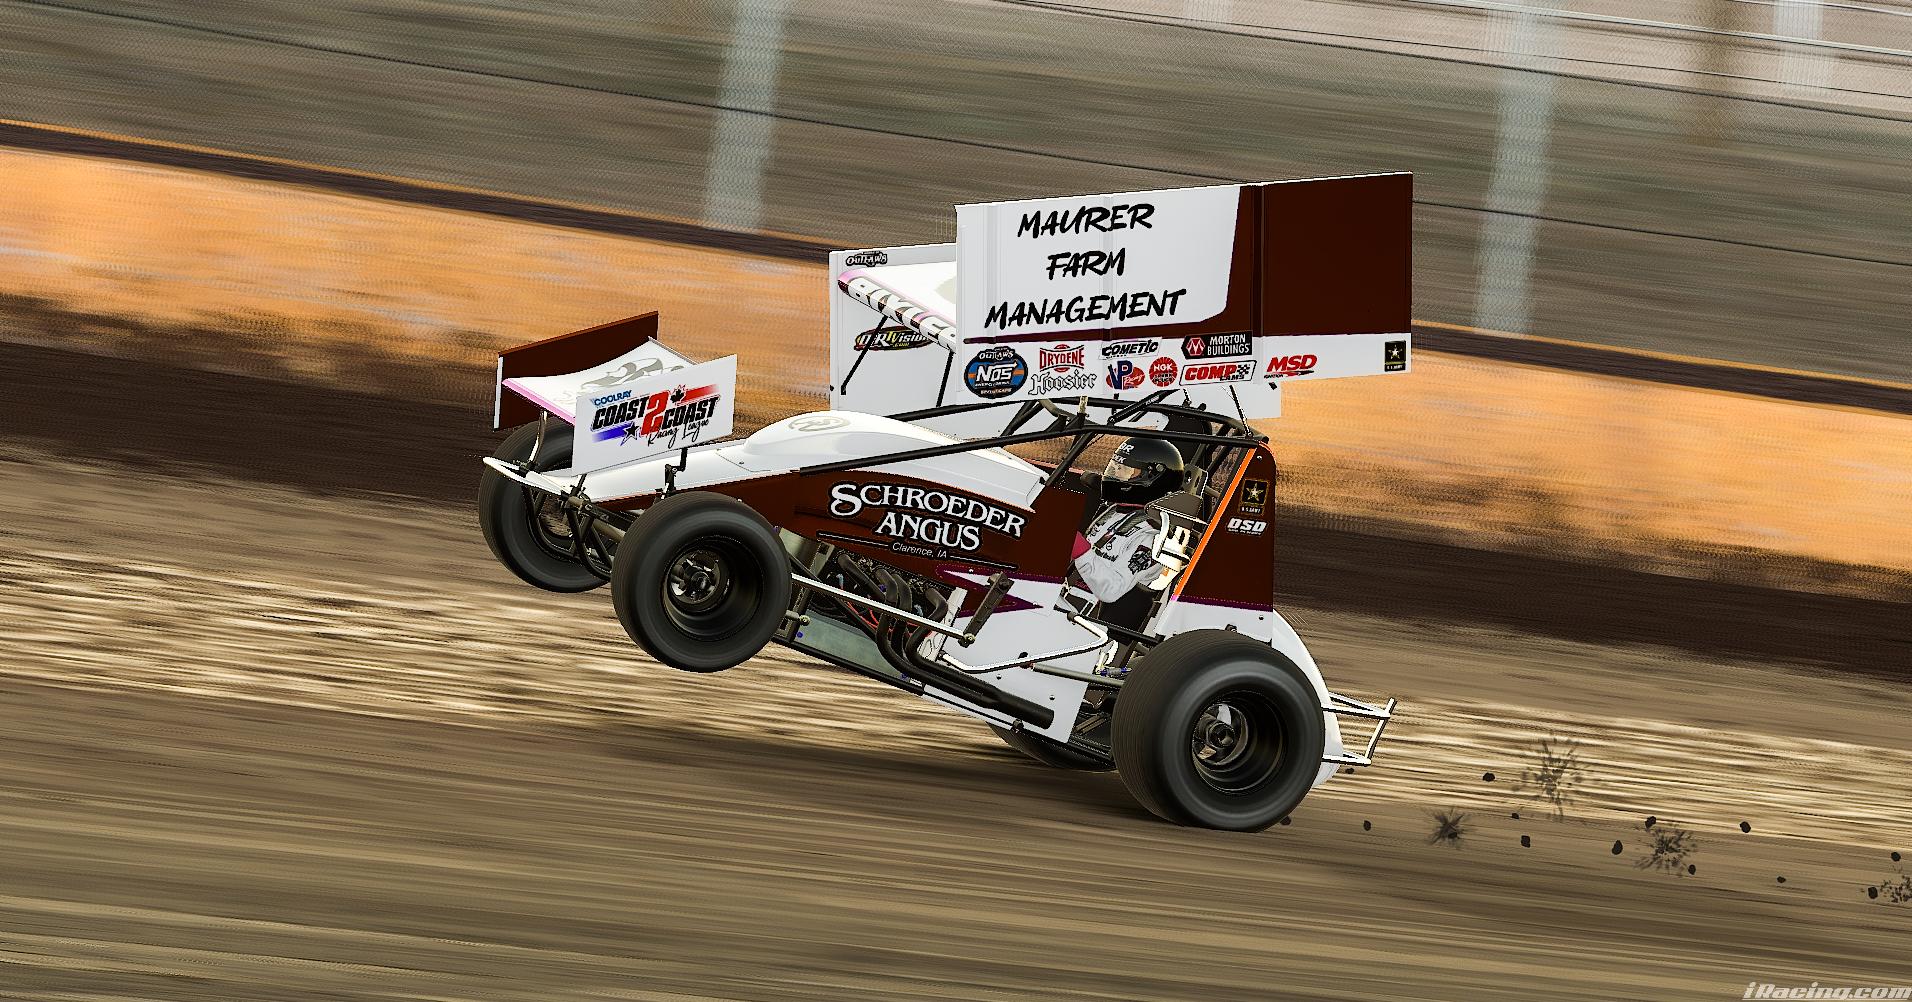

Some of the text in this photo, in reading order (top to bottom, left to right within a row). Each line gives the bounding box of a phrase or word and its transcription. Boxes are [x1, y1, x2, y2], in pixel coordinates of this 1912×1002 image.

[1017, 203, 1155, 239] MAURER
[1046, 247, 1126, 281] FARM
[984, 289, 1187, 330] MANAGEMENT
[1102, 339, 1159, 355] COMETIC
[1209, 334, 1246, 345] MORTON
[1039, 348, 1085, 369] DRYDENE
[1207, 344, 1250, 356] BUILDINGS
[975, 362, 1018, 382] NOS
[1153, 363, 1173, 371] NGK
[1266, 354, 1318, 372] MSD
[1028, 369, 1098, 395] Hoosier
[1184, 365, 1237, 381] COMP
[594, 390, 632, 406] COOLRAY
[647, 418, 709, 449] Racing League
[830, 483, 1025, 538] SCHROEDER
[875, 512, 980, 550] ANGUS
[1227, 518, 1267, 532] DSD
[892, 541, 948, 558] Clarence, IA
